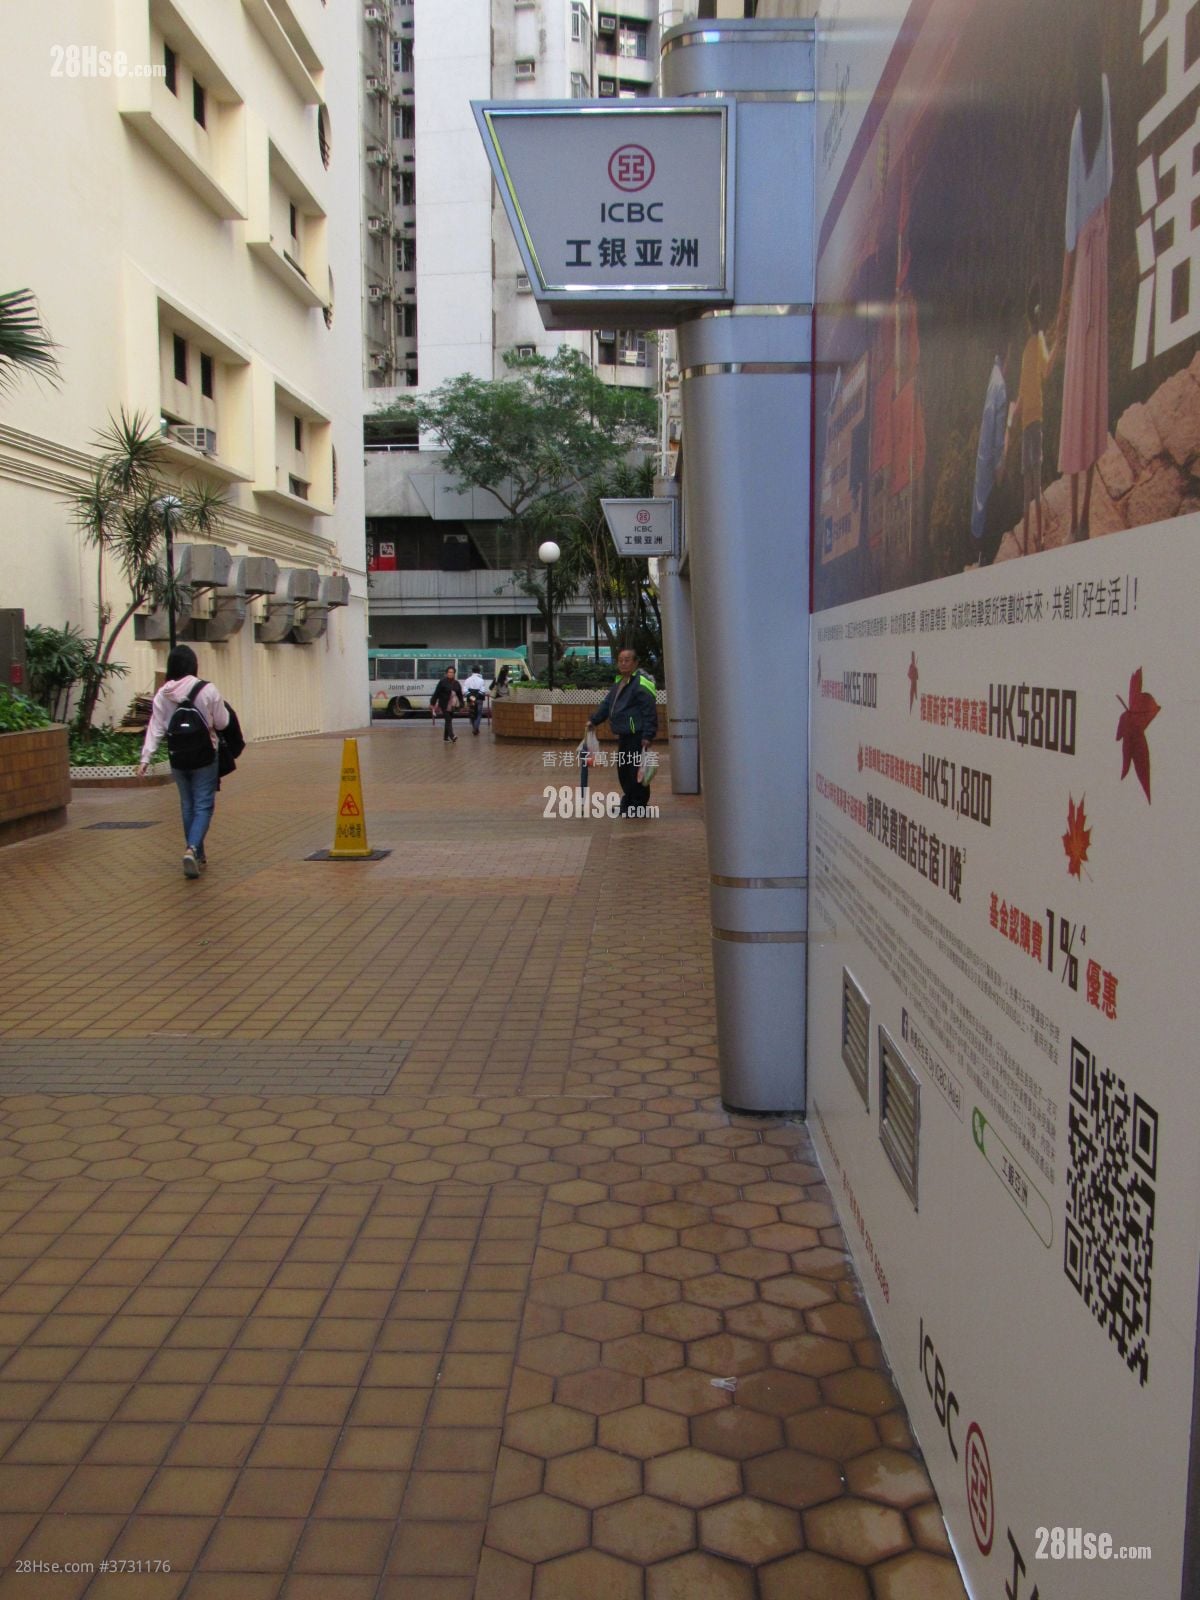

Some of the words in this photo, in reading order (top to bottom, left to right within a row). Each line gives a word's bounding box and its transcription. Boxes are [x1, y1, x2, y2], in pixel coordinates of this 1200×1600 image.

[600, 202, 663, 223] ICBC
[565, 237, 699, 267] 工银亚洲
[634, 525, 653, 533] ICBC
[988, 681, 1077, 756] HK$800
[921, 752, 992, 828] HK$1,800
[920, 1316, 960, 1464] ICBC
